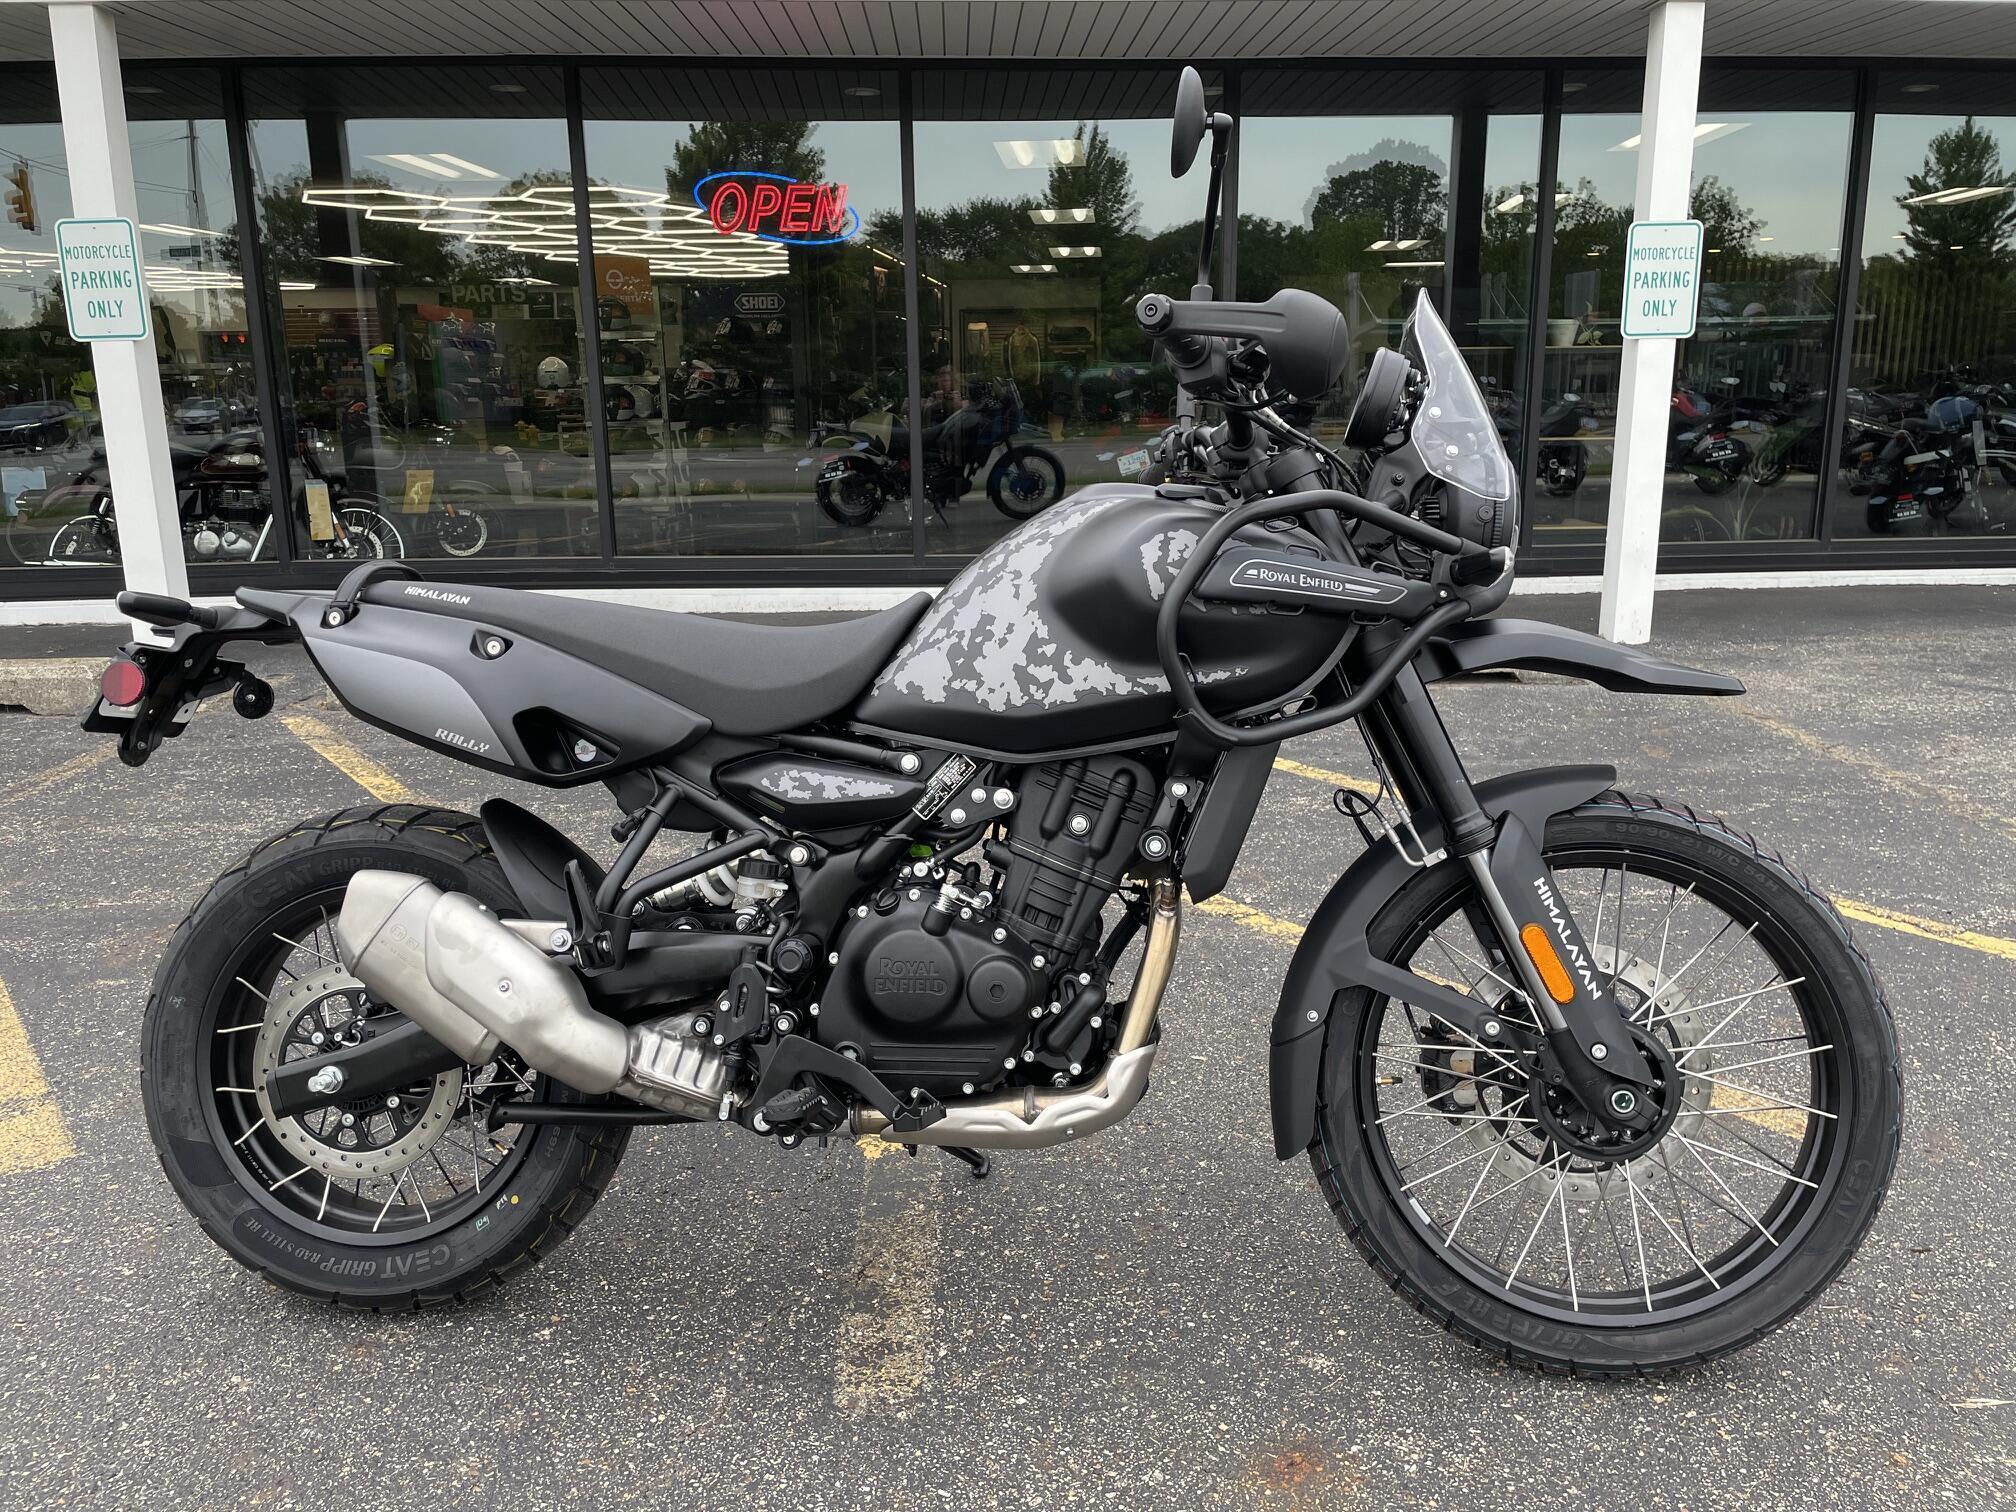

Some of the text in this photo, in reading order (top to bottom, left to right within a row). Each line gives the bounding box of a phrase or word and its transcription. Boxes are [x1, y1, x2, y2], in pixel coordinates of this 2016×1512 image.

[710, 182, 848, 234] OPEN
[64, 244, 132, 260] MOTORCYCLE
[1633, 247, 1695, 260] MOTORCYCLE
[71, 270, 132, 289] PARKING
[1634, 271, 1690, 288] PARKING
[452, 284, 527, 303] PARTS
[741, 296, 779, 309] SHOEI
[87, 300, 124, 319] ONLY
[1643, 299, 1677, 317] ONLY
[1259, 568, 1343, 592] ROYAL ENFIELD
[404, 585, 471, 605] HIMALAYAN
[434, 727, 490, 753] RALLY
[1533, 876, 1602, 1000] HIMALAYAN
[879, 957, 939, 977] ROYAL
[873, 977, 949, 996] ENFIELD
[260, 1228, 295, 1251] STEEL
[293, 1246, 321, 1263] RAD
[380, 1244, 450, 1279] CEAT
[319, 1257, 377, 1277] GRIPP
